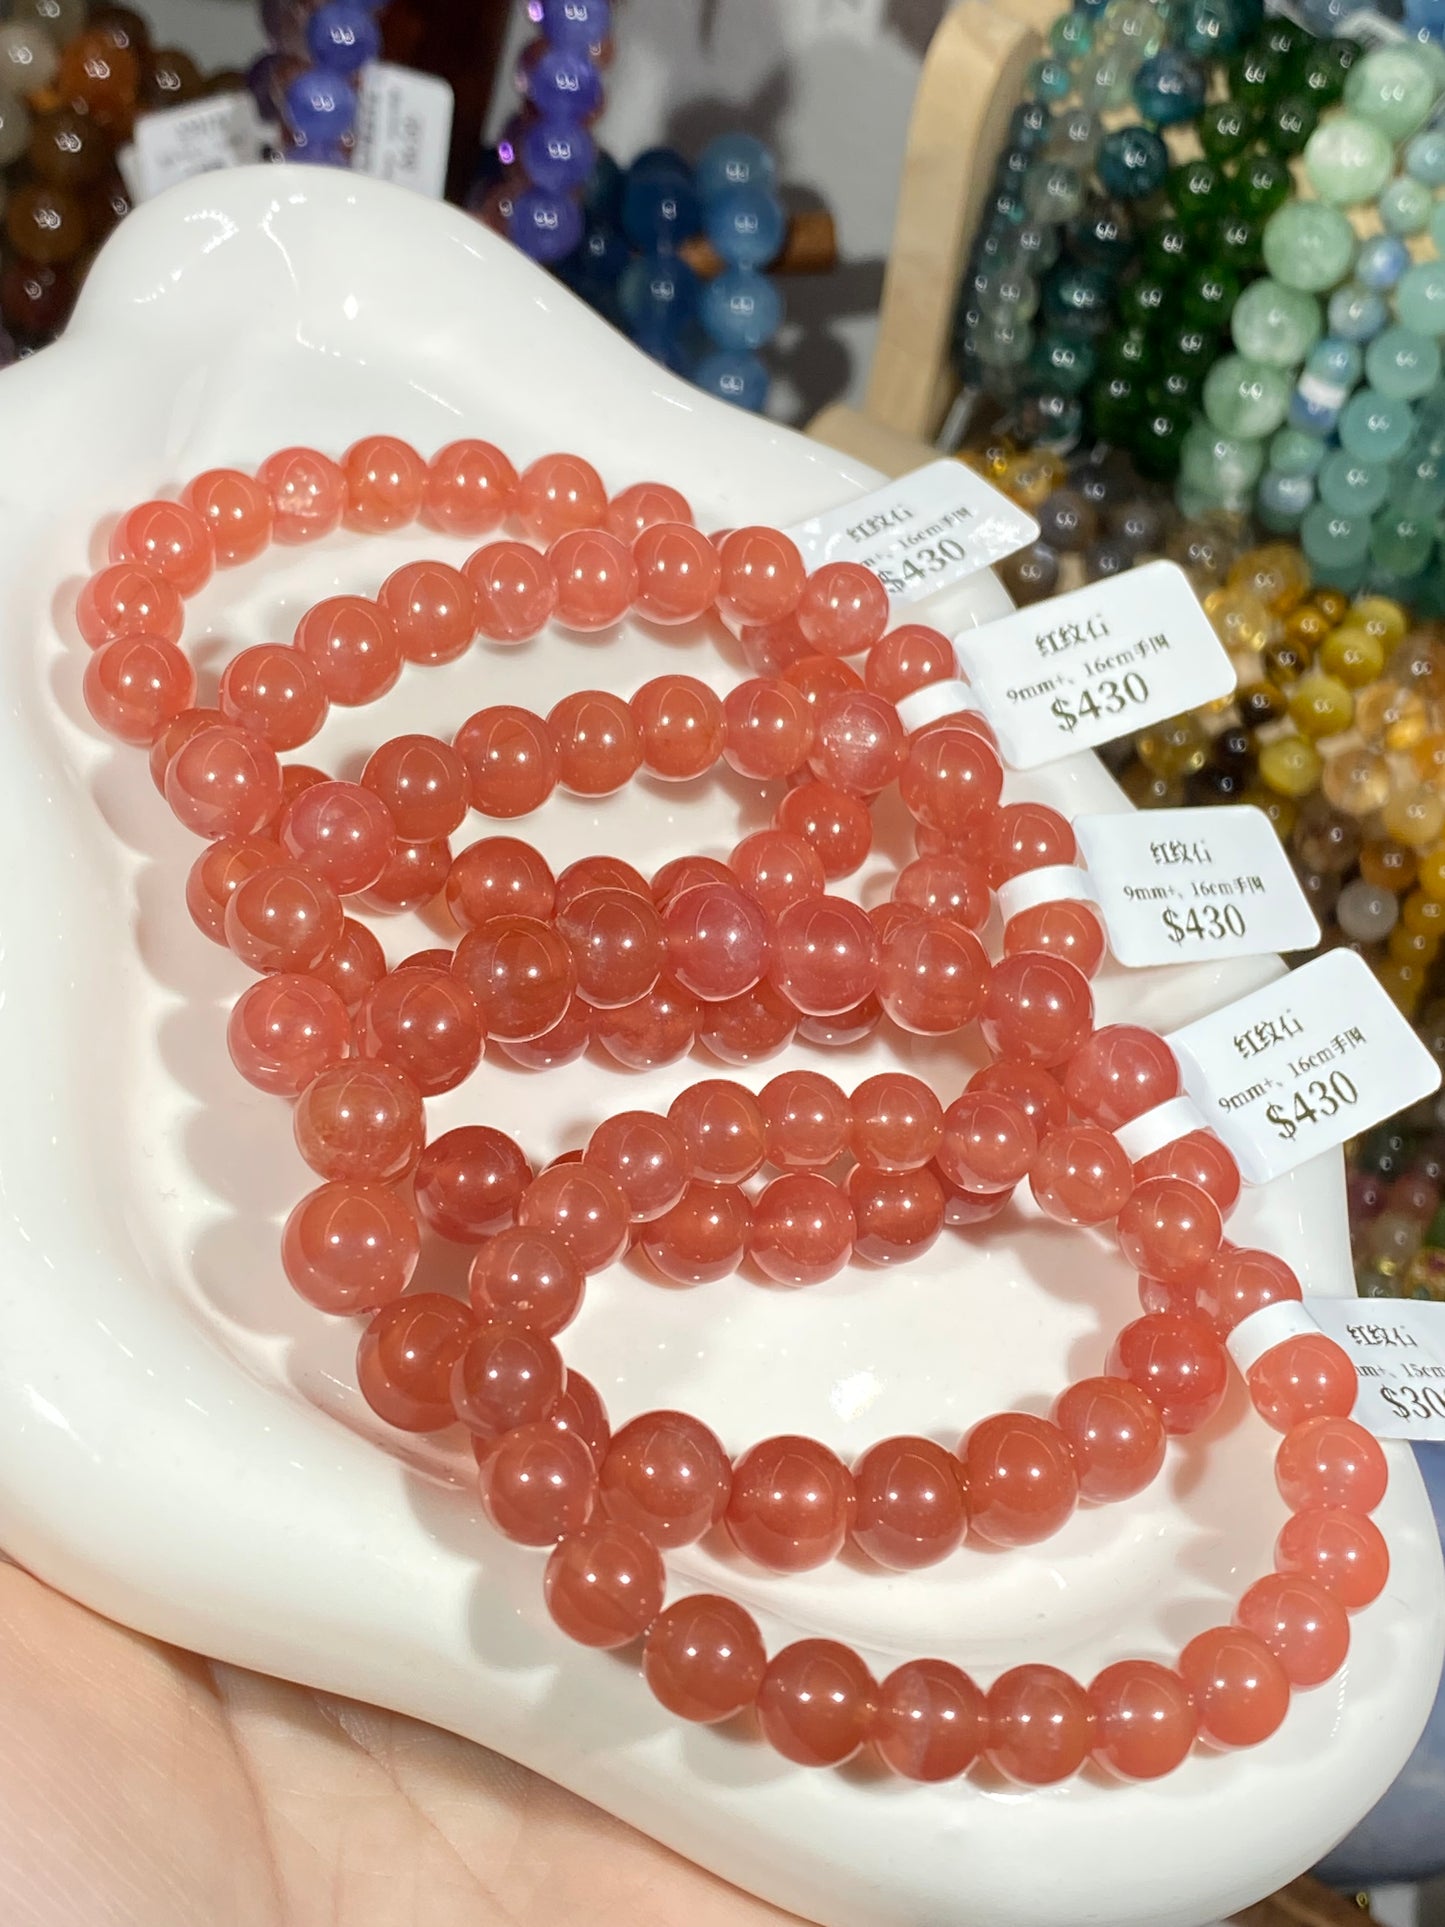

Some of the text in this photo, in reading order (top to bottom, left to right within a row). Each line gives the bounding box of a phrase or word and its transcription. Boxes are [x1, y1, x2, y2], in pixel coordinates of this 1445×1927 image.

[878, 539, 966, 594] $430
[1050, 671, 1149, 733] $430
[1162, 903, 1246, 947] $430
[1266, 1070, 1358, 1142] $430
[1380, 1384, 1445, 1422] $30
